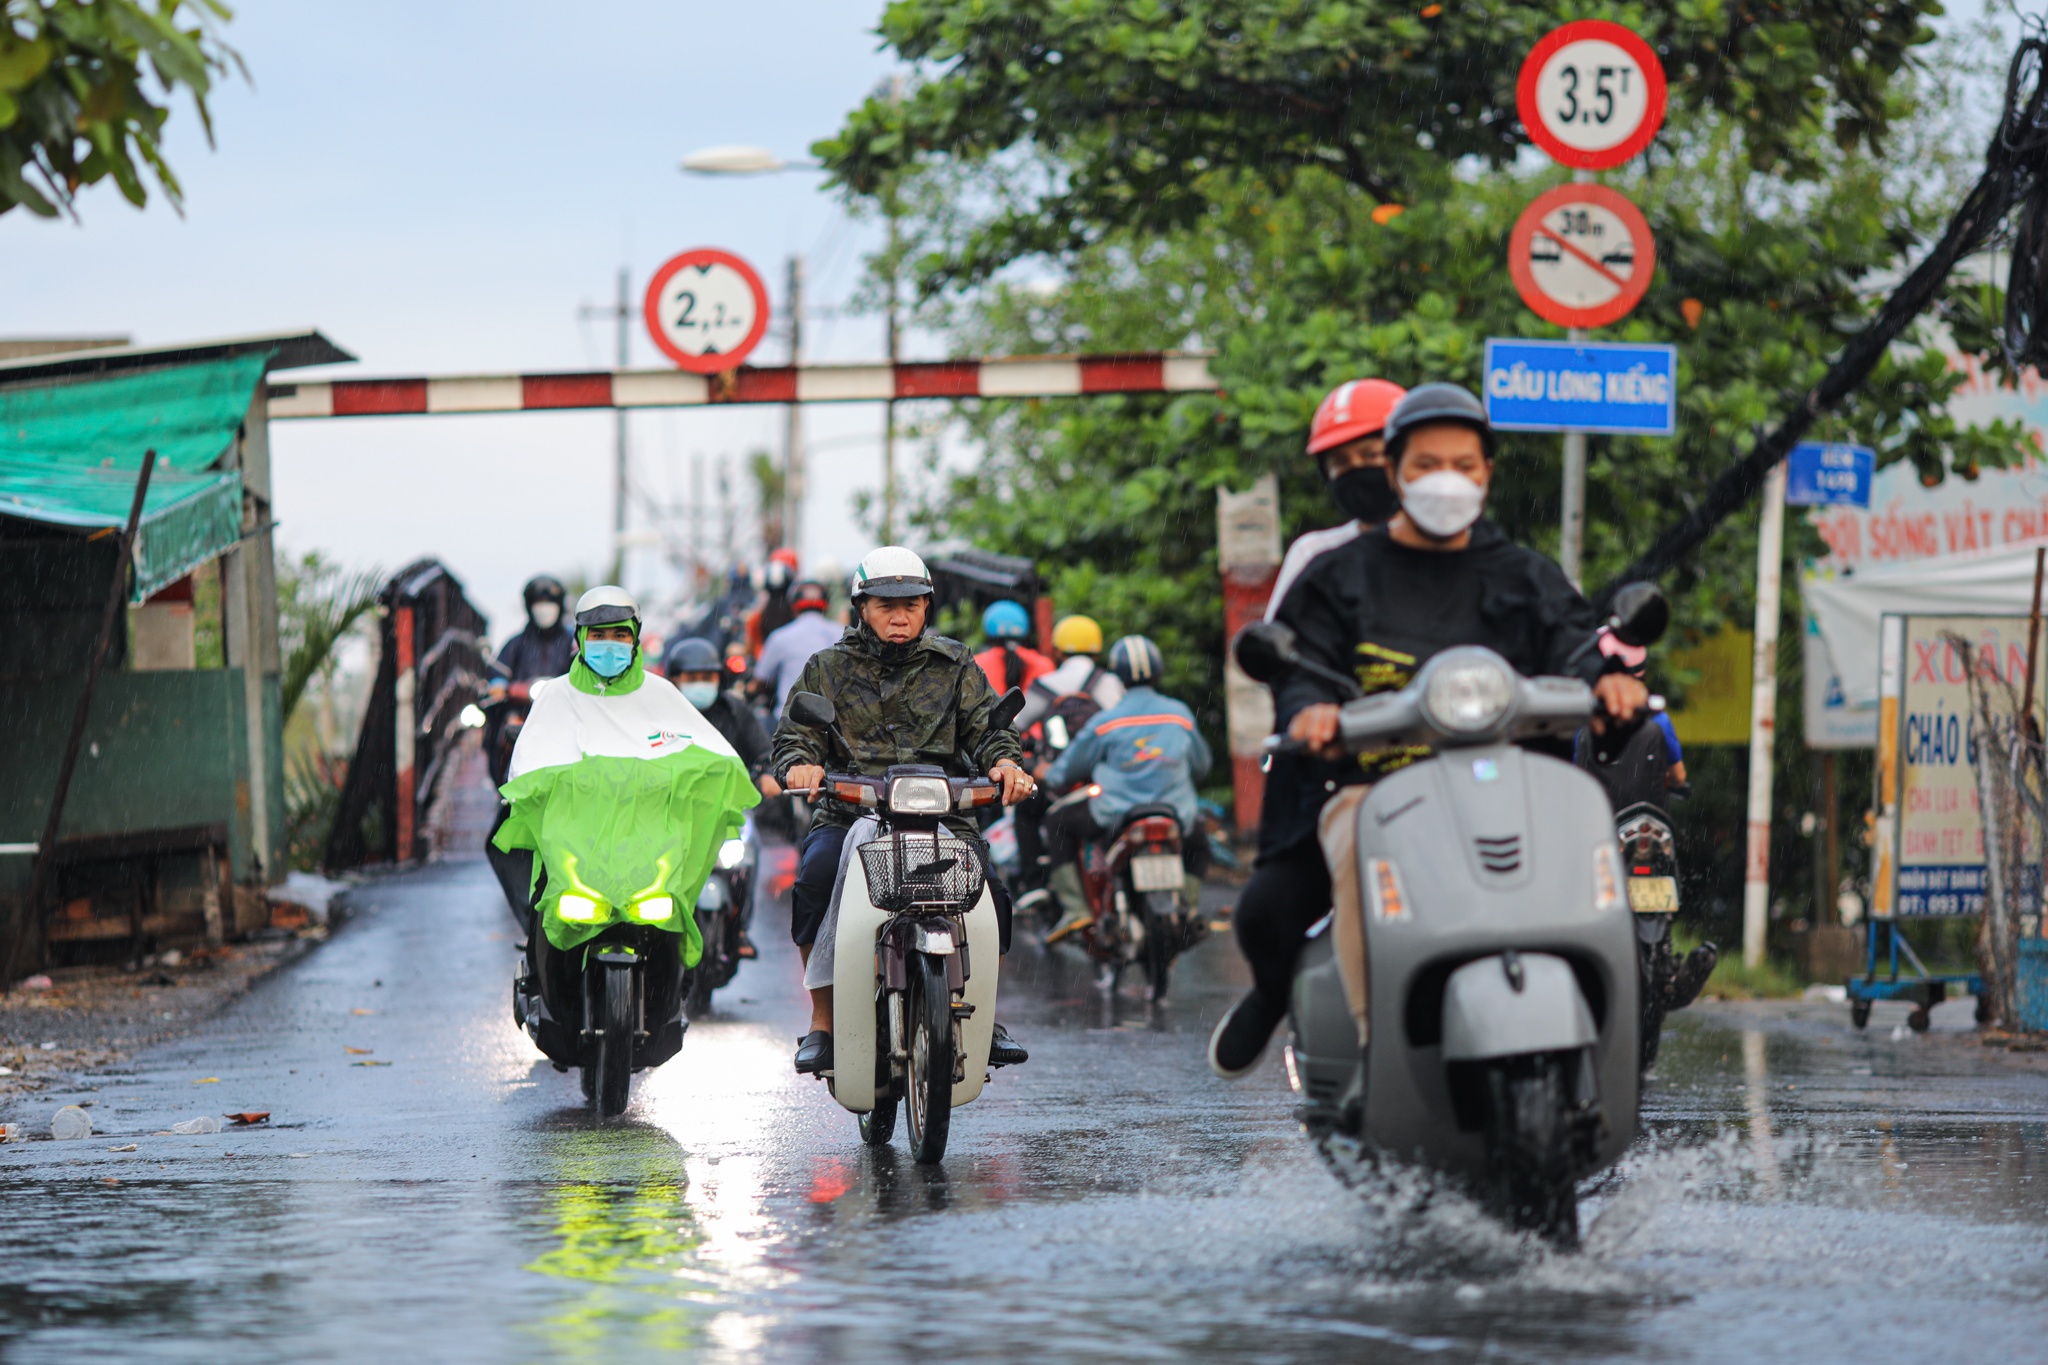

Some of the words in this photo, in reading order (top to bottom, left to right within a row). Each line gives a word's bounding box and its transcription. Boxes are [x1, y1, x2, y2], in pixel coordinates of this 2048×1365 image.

[1547, 369, 1603, 402] LONG
[1868, 497, 1940, 562] SỐNG
[1905, 697, 1960, 765] CHÁO
